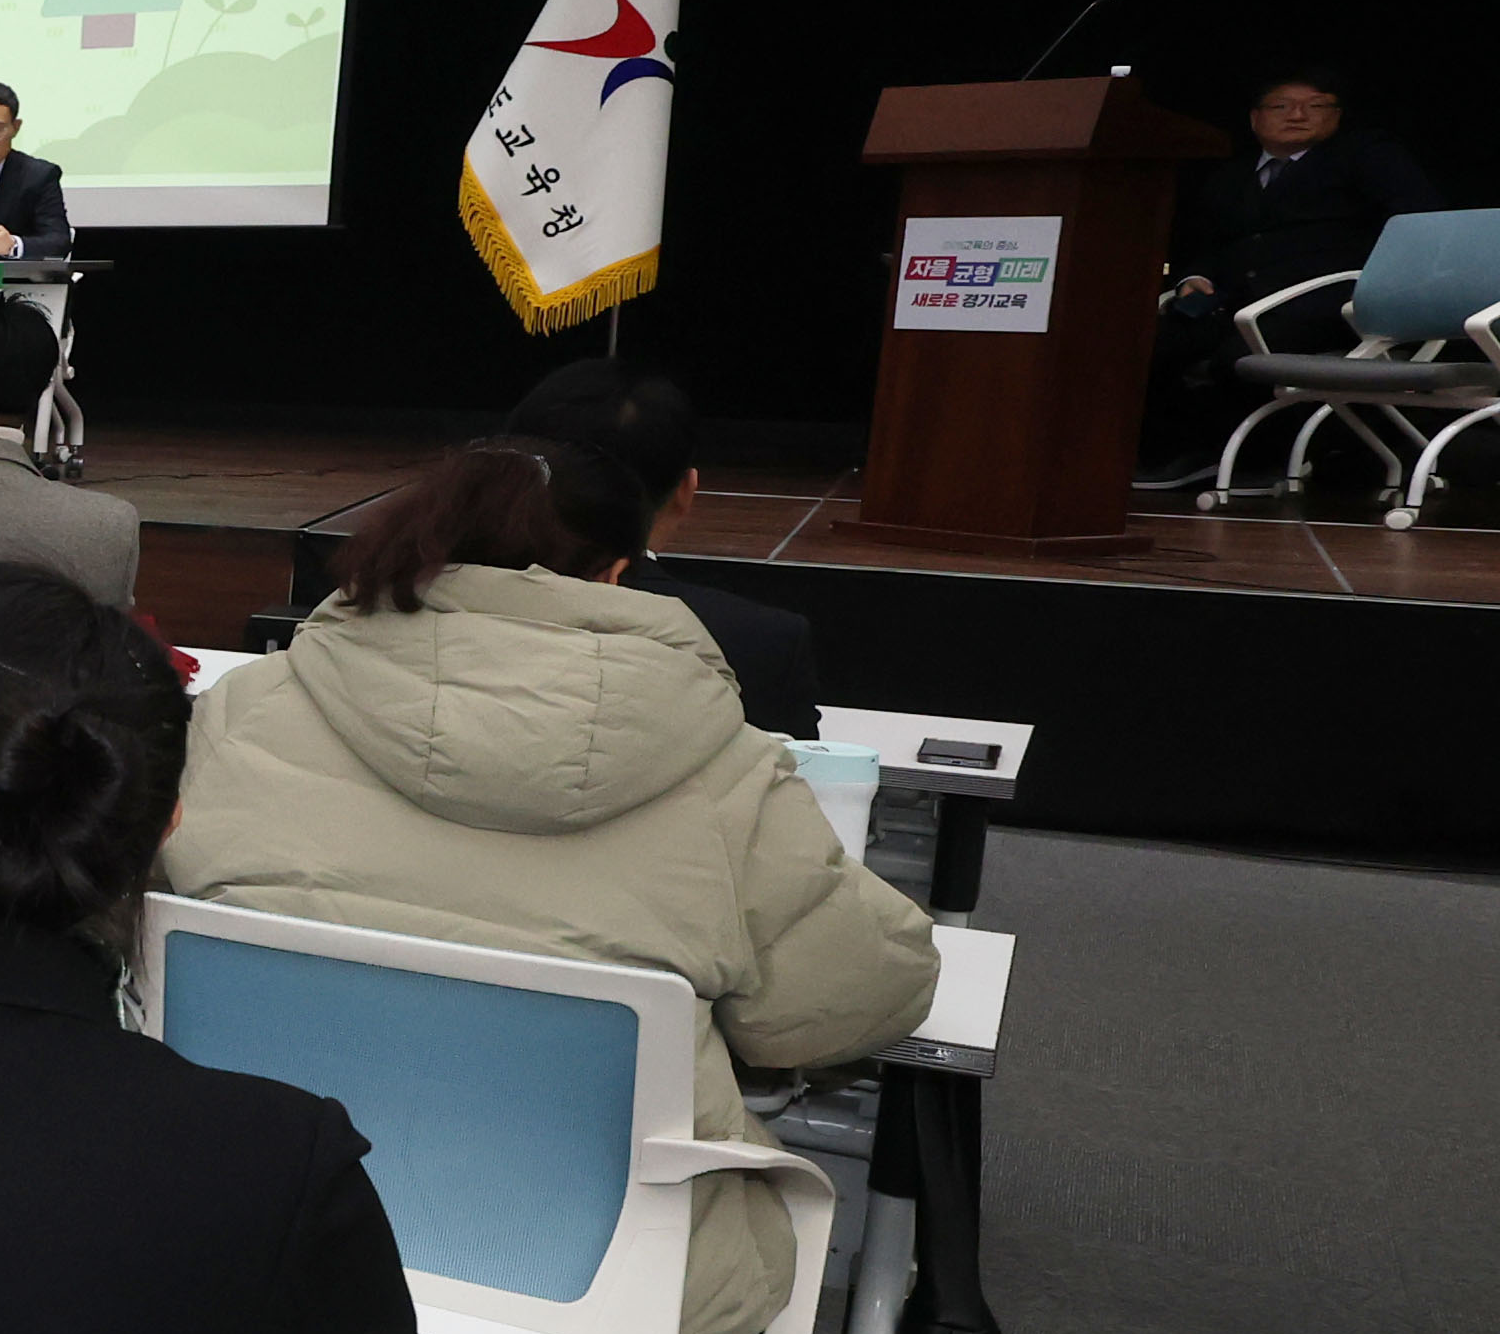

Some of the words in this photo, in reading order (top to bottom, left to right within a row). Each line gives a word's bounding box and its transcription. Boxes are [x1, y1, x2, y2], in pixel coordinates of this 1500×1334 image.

[909, 259, 951, 277] 자율
[952, 265, 995, 284] 균형
[1000, 261, 1044, 278] 미래
[910, 292, 960, 308] 새로운
[961, 293, 1029, 309] 경기교육
